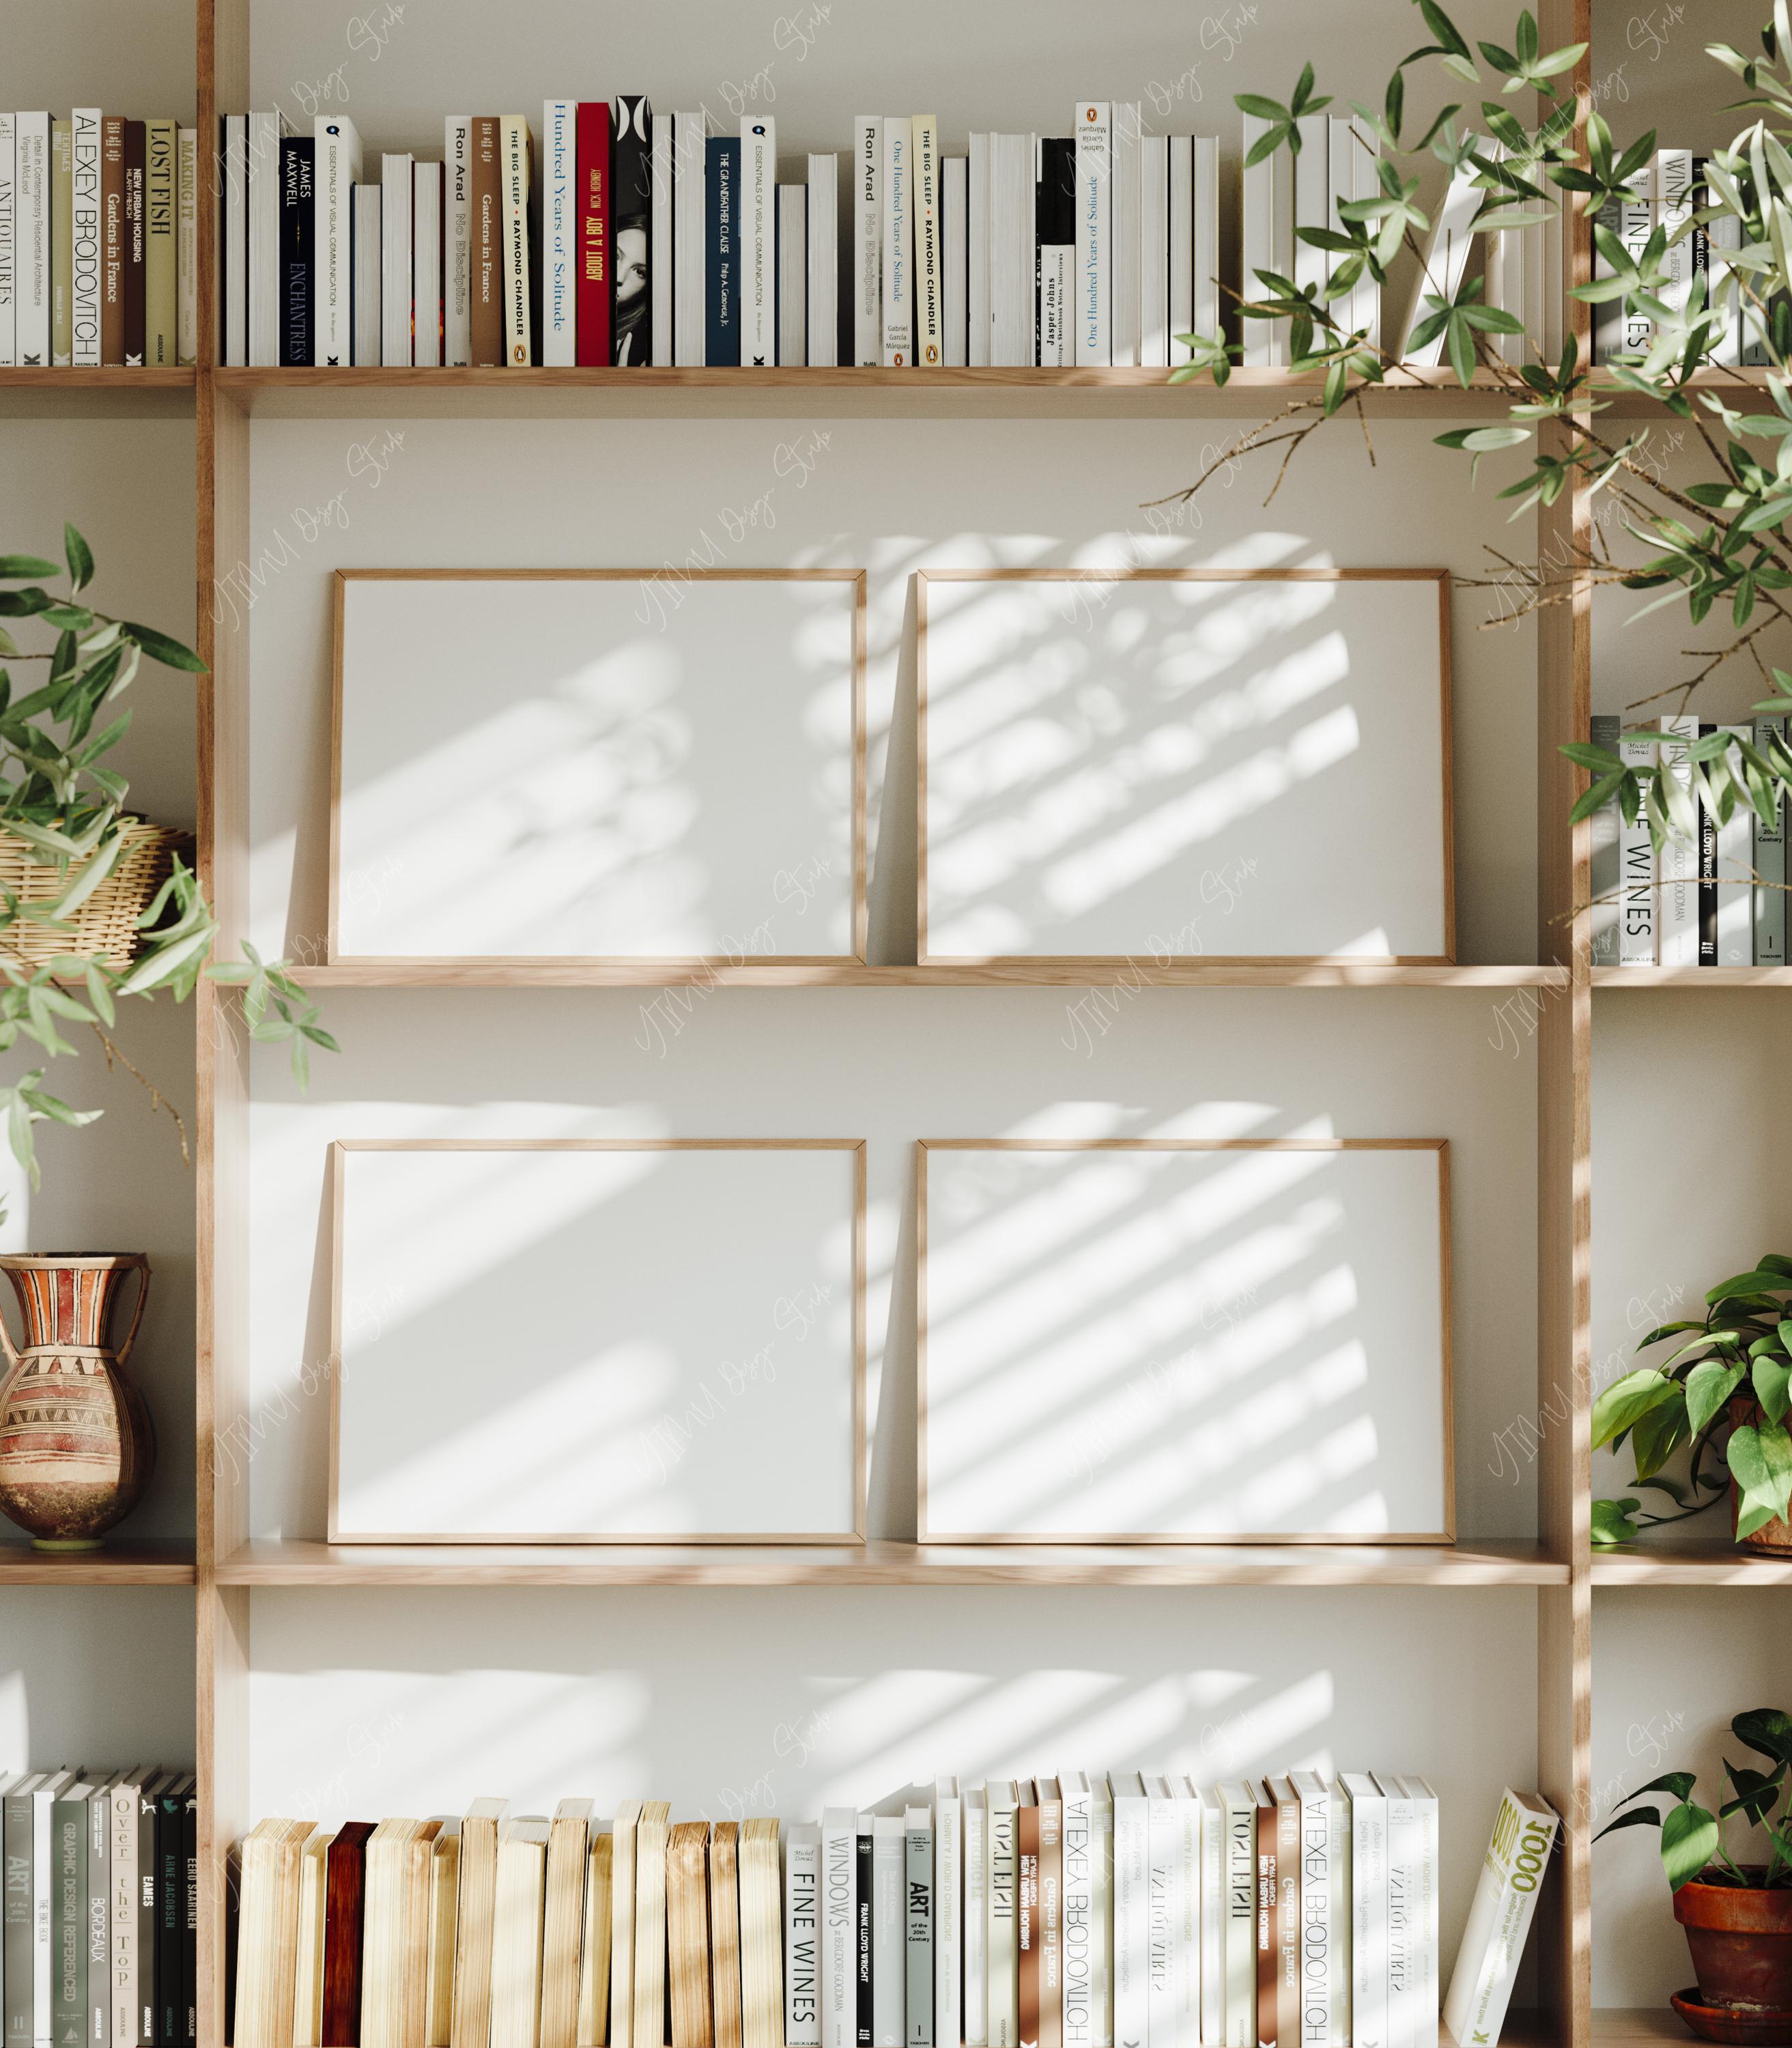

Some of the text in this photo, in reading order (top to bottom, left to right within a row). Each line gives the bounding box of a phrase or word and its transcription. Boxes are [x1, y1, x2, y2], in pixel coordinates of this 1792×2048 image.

[182, 140, 193, 207] MAKING
[287, 151, 297, 206] MAXWELL
[300, 159, 311, 197] JAMES
[456, 128, 465, 201] Ron Arad
[894, 141, 902, 163] One
[152, 128, 170, 235] LOST FISH
[329, 194, 337, 208] OF
[591, 168, 601, 208] NICK HORNBY
[720, 171, 729, 224] GRANDFATHER
[894, 167, 902, 211] Hundred
[75, 115, 97, 354] ALEXEY BRODOVITCH
[182, 210, 193, 220] IT
[554, 105, 565, 330] Hundred Years of Solitude
[586, 216, 603, 236] BOY
[720, 226, 729, 254] CLAUSE
[107, 193, 120, 302] Gardens in France
[455, 213, 466, 315] No Discipline
[586, 250, 603, 281] ABOUT
[894, 246, 902, 257] of
[1087, 176, 1098, 347] One Hundred Years of Solitude
[894, 261, 902, 302] Solitude
[290, 264, 305, 360] ENCHANTRESS
[1047, 277, 1056, 345] Jasper Johns
[1703, 827, 1712, 855] LLOYD
[1627, 844, 1651, 935] WINES
[63, 1822, 76, 1875] GRAPHIC
[116, 1799, 130, 1858] Over
[8, 1855, 29, 1896] ART
[63, 1877, 76, 1921] DESIGN
[118, 1877, 128, 1920] the
[143, 1876, 154, 1907] EAMES
[165, 1854, 175, 1929] ARNE JACOBSEN
[187, 1858, 197, 1929] EERO SAARINEN
[829, 1837, 849, 1926] WINDOWS
[911, 1881, 929, 1916] ART
[91, 1898, 105, 1963] BORDEAUX
[793, 1874, 814, 2022] FINE WINES
[834, 1937, 844, 1973] BERGDORF
[63, 1925, 76, 2002] REFERENCED
[834, 1974, 844, 2012] GOODMAN
